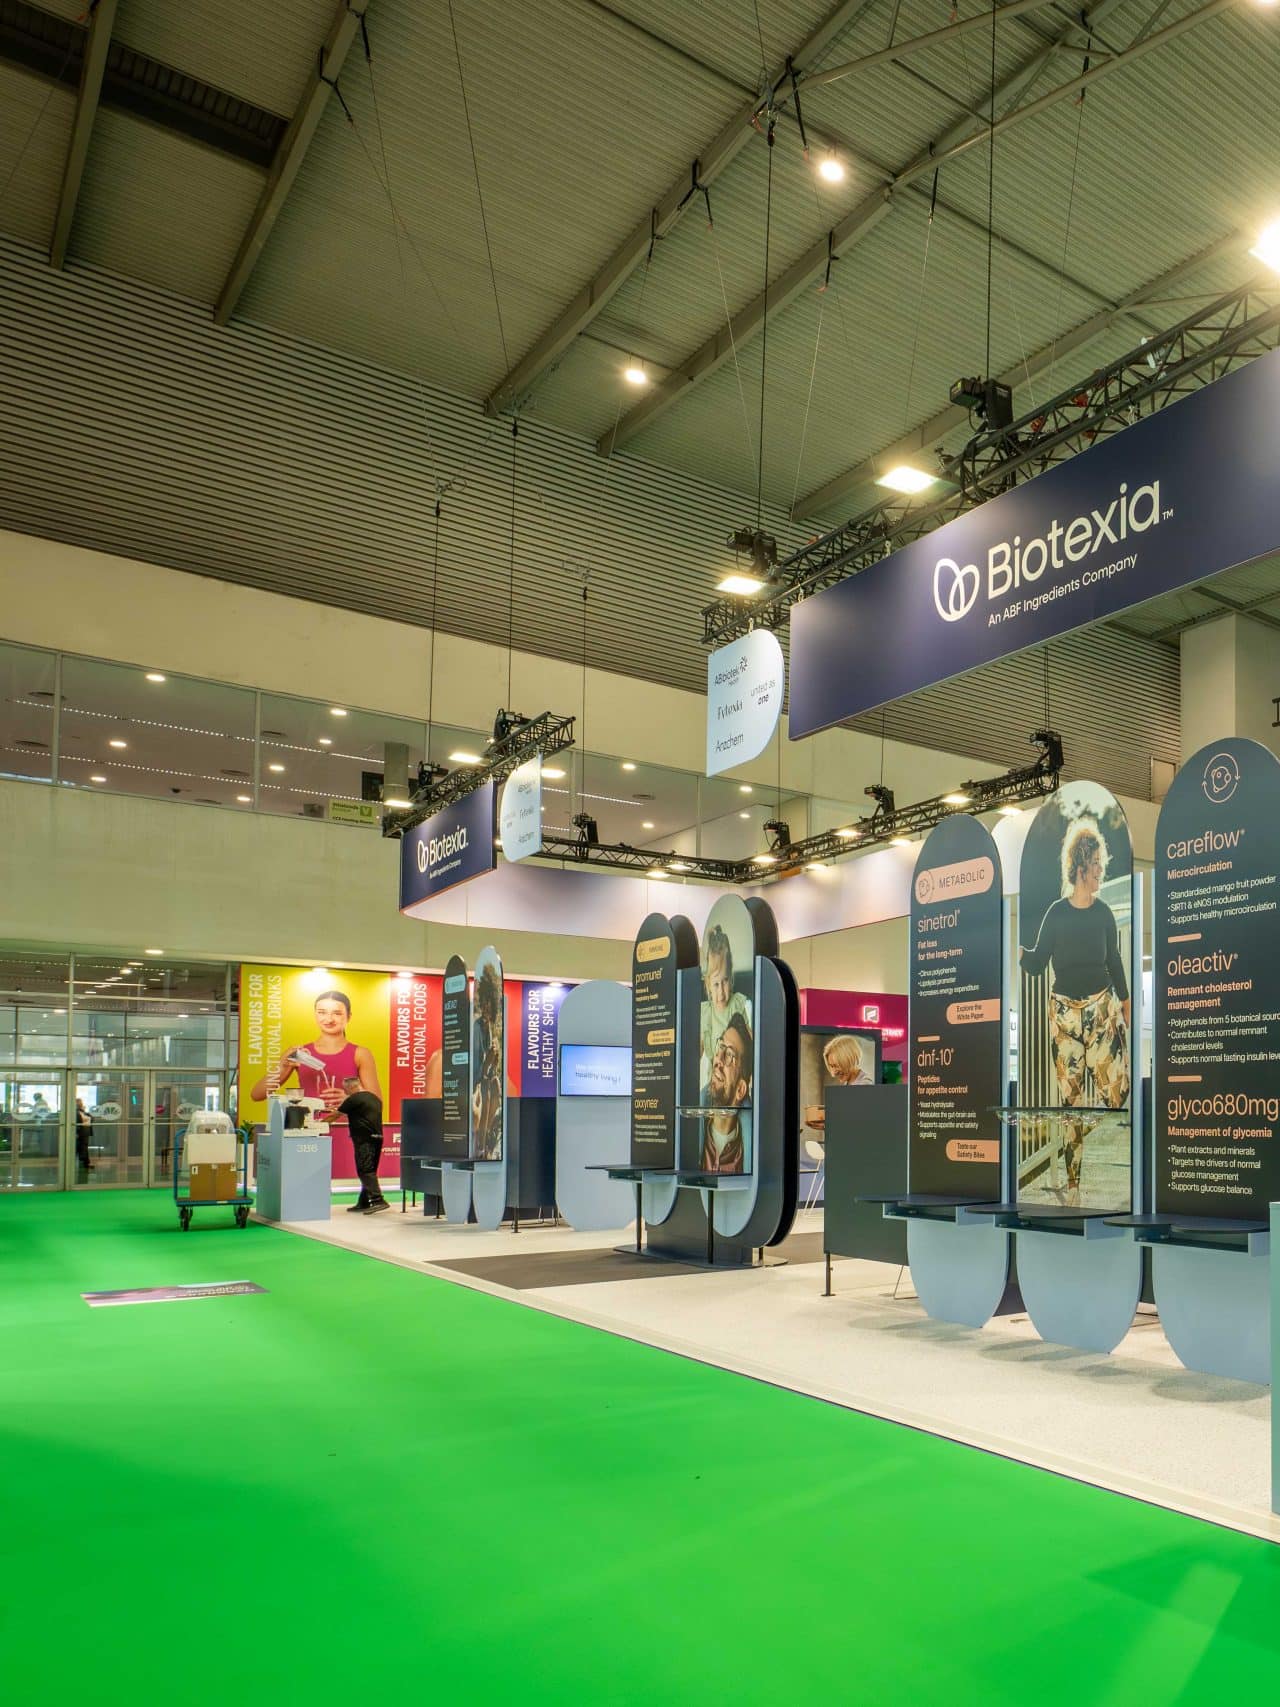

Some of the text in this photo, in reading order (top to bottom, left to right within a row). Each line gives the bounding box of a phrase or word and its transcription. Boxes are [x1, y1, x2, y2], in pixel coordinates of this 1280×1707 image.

[989, 480, 1160, 600] Biotexia
[988, 553, 1138, 628] An ABF Ingredients Company
[430, 825, 467, 866] Biotexia
[939, 869, 985, 889] METABOLIC
[1168, 861, 1233, 880] Microcirculation
[1212, 883, 1235, 893] mango
[1236, 880, 1249, 889] fruit
[1250, 875, 1277, 889] powder
[1213, 893, 1249, 905] modulation
[1171, 902, 1277, 925] Supports healthy microcirculation
[936, 949, 963, 959] long-term
[1168, 979, 1252, 997] Remnant cholesterol
[1168, 997, 1221, 1011] management
[249, 974, 263, 1065] FLAVOURS FOR
[1171, 1016, 1208, 1028] Polyphenols
[1209, 1016, 1224, 1025] from
[1225, 1015, 1230, 1024] 5
[1231, 1013, 1261, 1023] botanical
[266, 976, 282, 1099] FUNCTIONAL DRINKS
[397, 1008, 411, 1068] FLAVOURS
[528, 990, 540, 1070] FLAVOURS FOR
[1171, 1026, 1268, 1040] Contributes to normal remnant
[413, 984, 427, 1095] FUNCTIONAL FOODS
[1171, 1041, 1224, 1052] cholesterol levels
[542, 1031, 554, 1078] HEALTHY
[1171, 1055, 1200, 1066] Supports
[1201, 1053, 1223, 1063] normal
[1224, 1053, 1246, 1064] fasting
[1247, 1052, 1269, 1061] insulin
[926, 1086, 948, 1096] appetite
[949, 1085, 969, 1094] control
[1168, 1126, 1273, 1140] Management of glycemia
[1171, 1144, 1256, 1156] Plant extracts and minerals
[1171, 1157, 1261, 1169] Targets the drivers of normal
[1171, 1170, 1239, 1182] glucose management
[1171, 1182, 1253, 1195] Supports glucose balance
